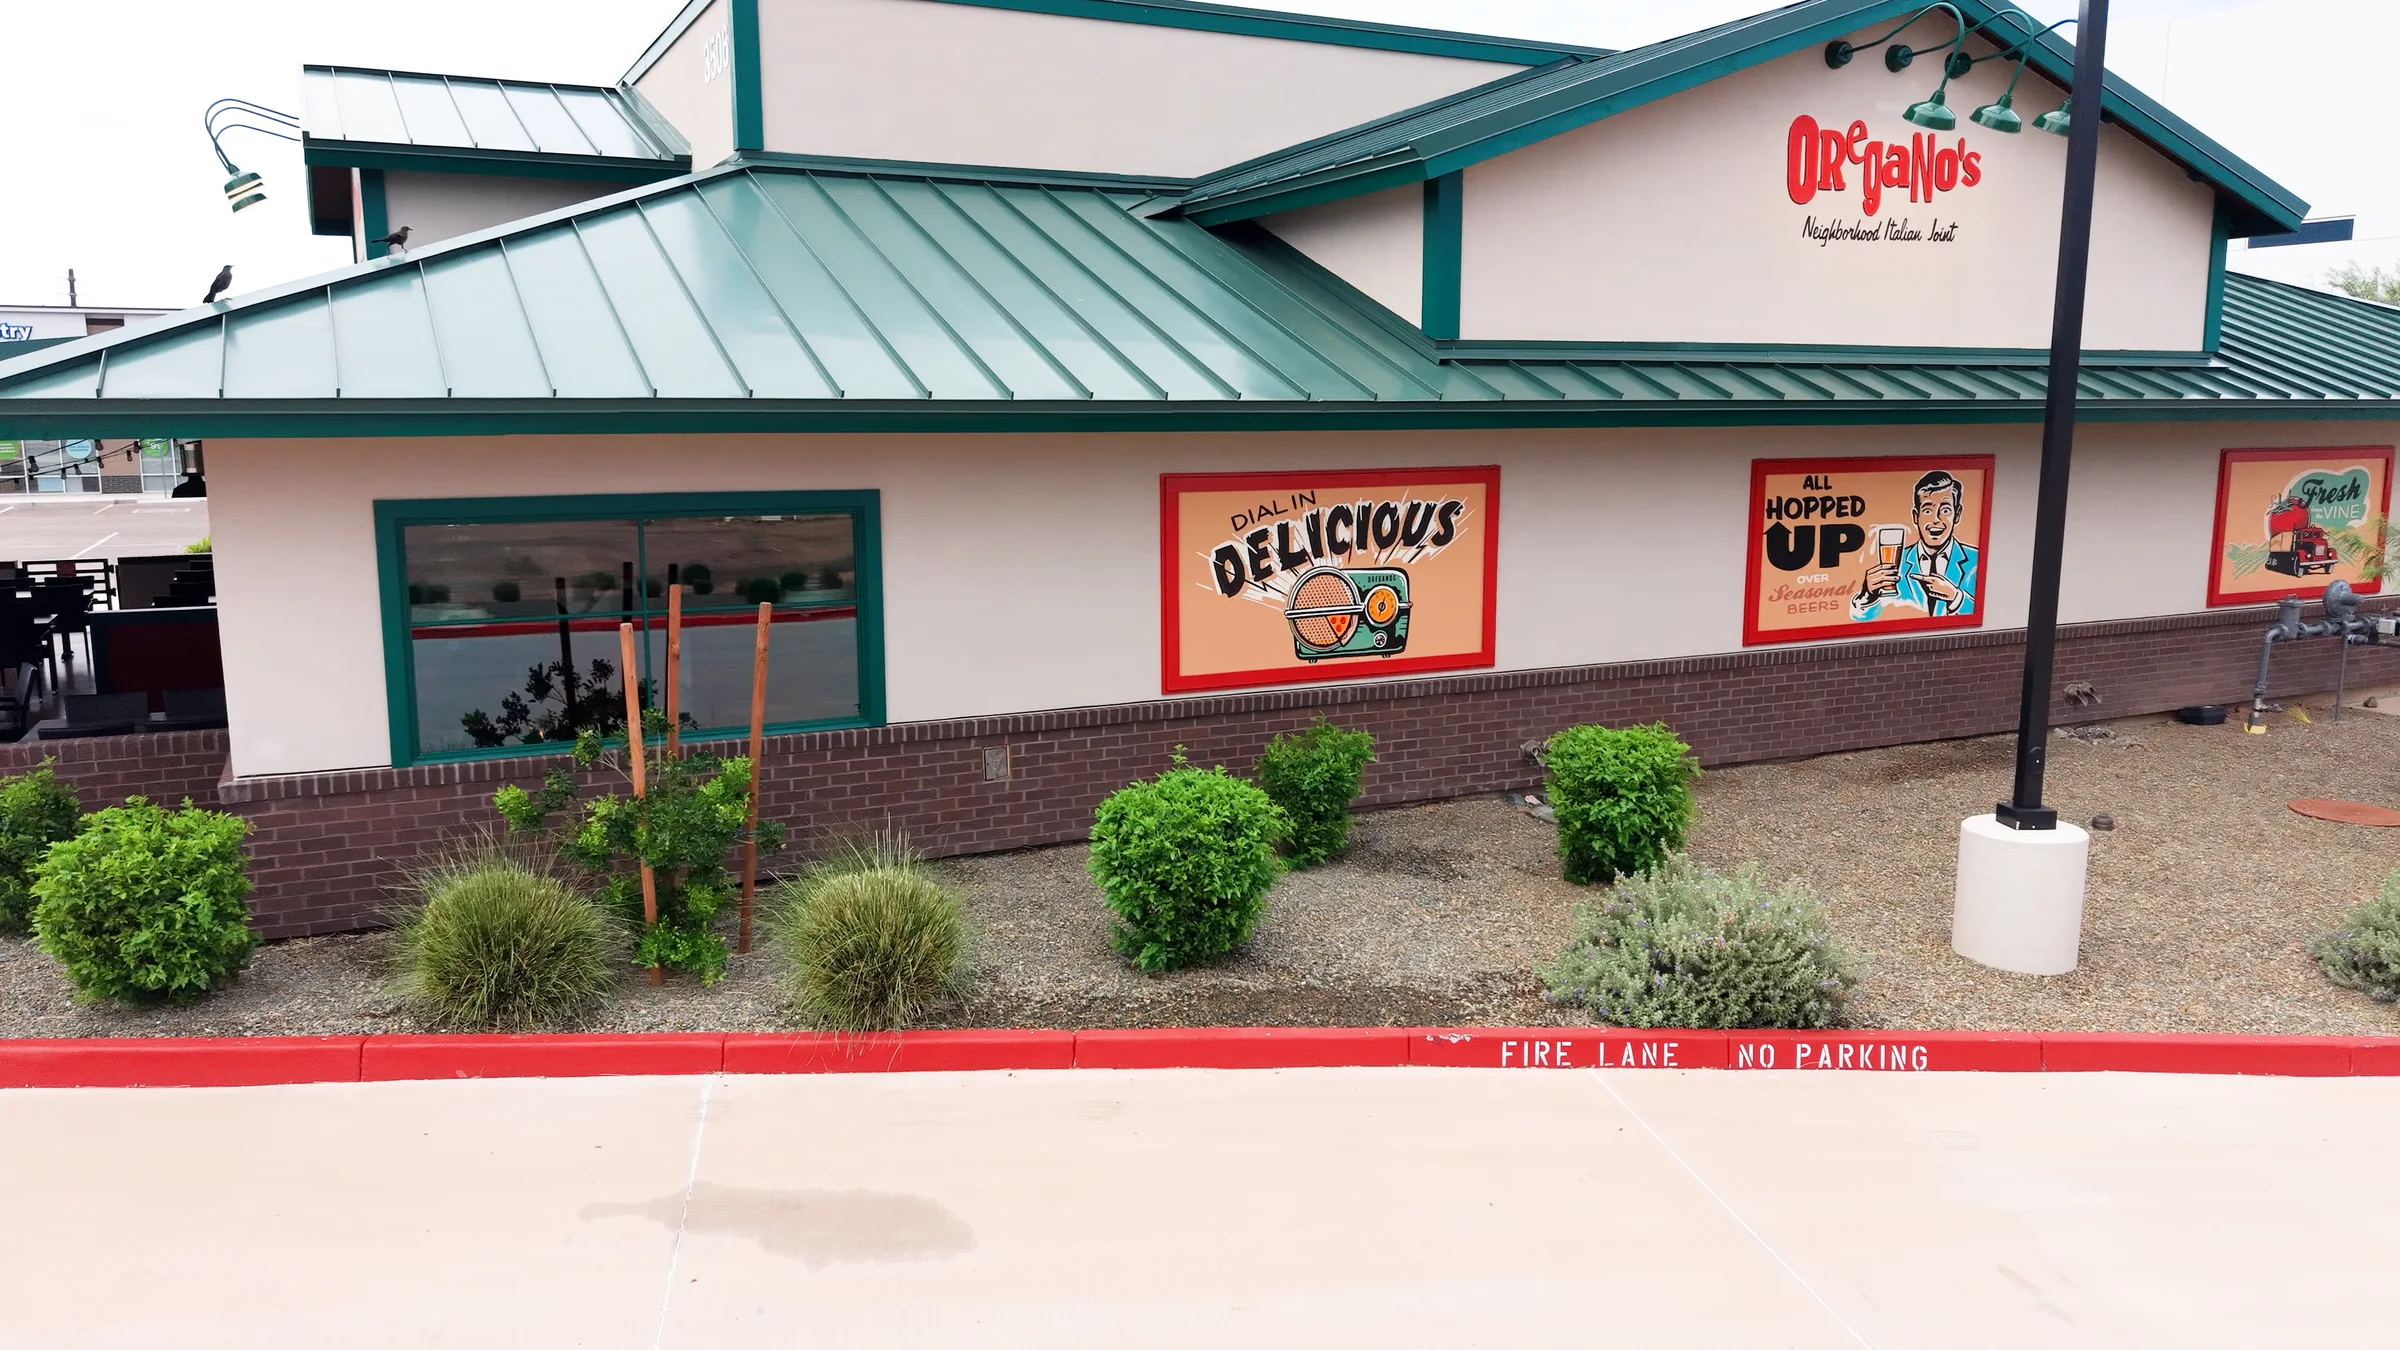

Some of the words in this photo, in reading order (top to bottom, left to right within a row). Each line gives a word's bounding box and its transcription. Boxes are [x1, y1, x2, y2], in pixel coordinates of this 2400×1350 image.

[1802, 215, 1882, 247] Neighborhood
[1883, 217, 1922, 241] Italian
[1927, 218, 1958, 242] Joint
[1803, 475, 1832, 490] ALL
[2302, 476, 2361, 508] Fresh
[1231, 500, 1288, 531] DIAL
[1291, 490, 1316, 510] IN
[1766, 495, 1865, 520] HOPPED
[2323, 504, 2360, 519] VINE
[1212, 499, 1464, 598] DELICIOUS
[1763, 521, 1865, 571] UP
[1768, 580, 1856, 602] Seasonal
[1796, 573, 1829, 584] OVER
[1787, 600, 1839, 614] BEERS
[1502, 1041, 1572, 1067] FIRE
[1600, 1042, 1679, 1067] LANE
[1738, 1043, 1775, 1069] NO
[1796, 1043, 1928, 1071] PARKING
